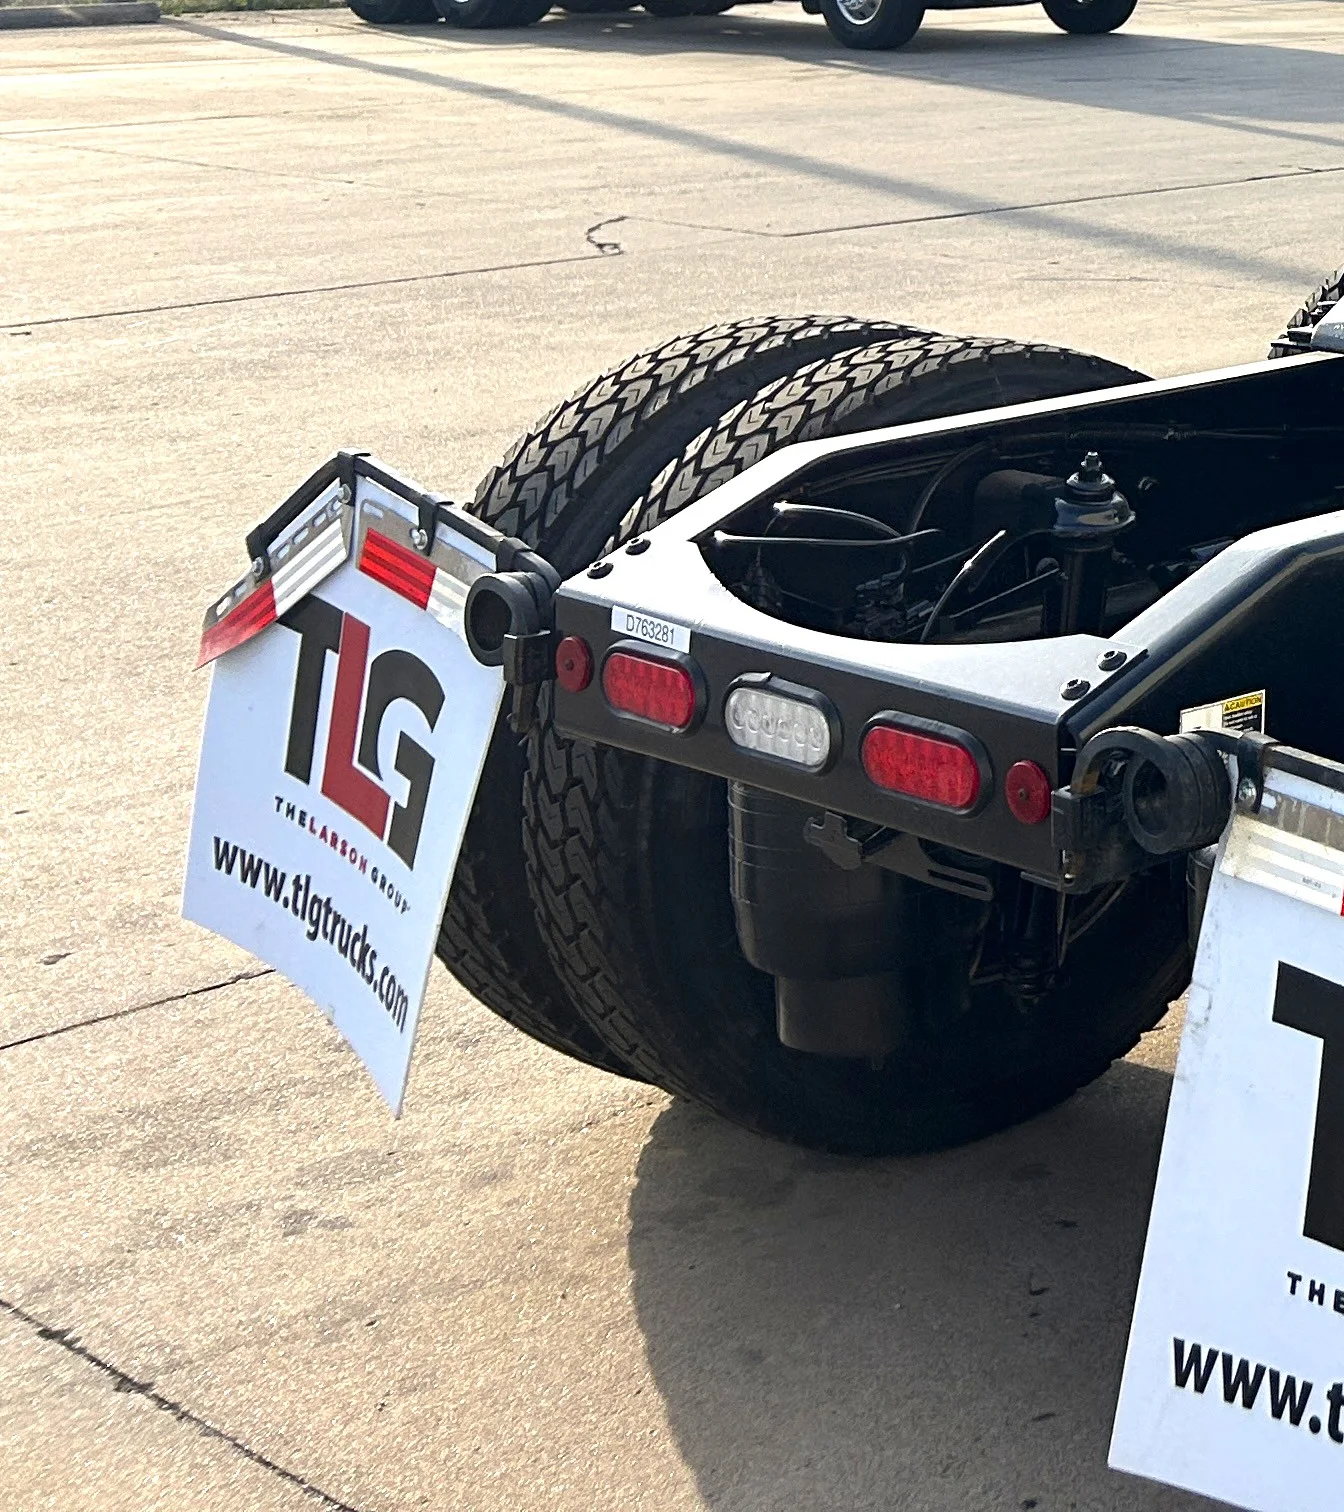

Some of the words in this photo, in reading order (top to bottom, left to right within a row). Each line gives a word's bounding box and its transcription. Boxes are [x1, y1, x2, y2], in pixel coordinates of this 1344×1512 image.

[626, 614, 675, 645] D763281
[276, 593, 446, 871] TLG
[213, 836, 409, 1034] www.tlgtrucks.com
[371, 866, 411, 915] GROUP
